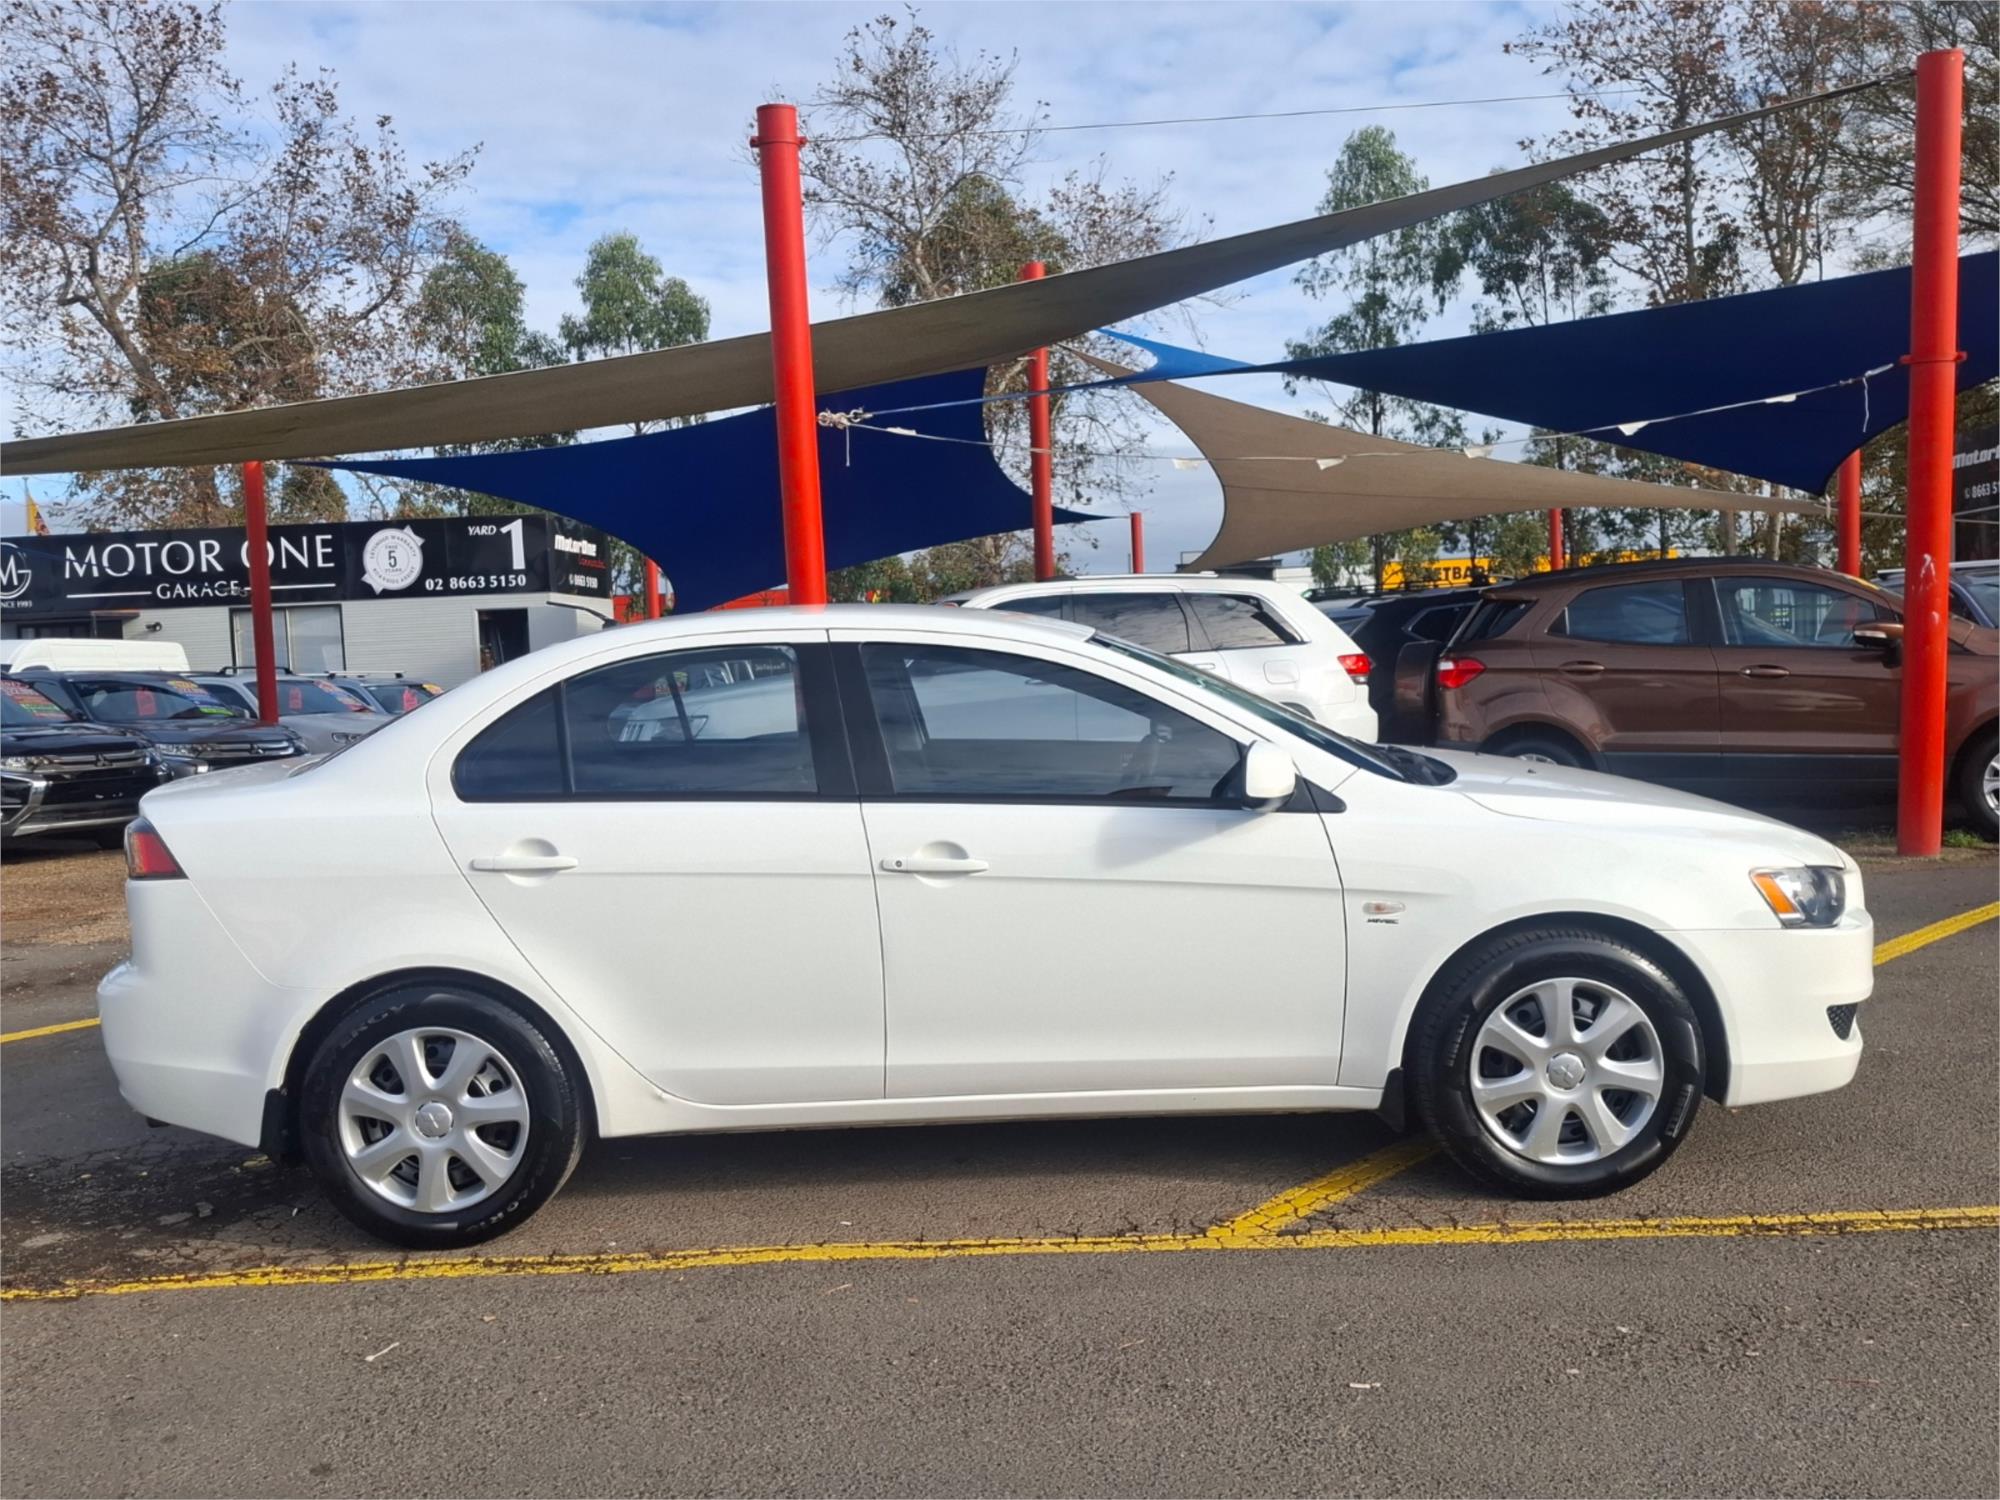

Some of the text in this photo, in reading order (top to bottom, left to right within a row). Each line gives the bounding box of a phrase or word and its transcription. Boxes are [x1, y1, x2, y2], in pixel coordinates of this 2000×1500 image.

[468, 525, 497, 536] YARD
[500, 518, 526, 570] 1
[65, 541, 223, 579] MOTOR
[388, 550, 397, 568] 5
[425, 574, 527, 591] 02 8663 5150
